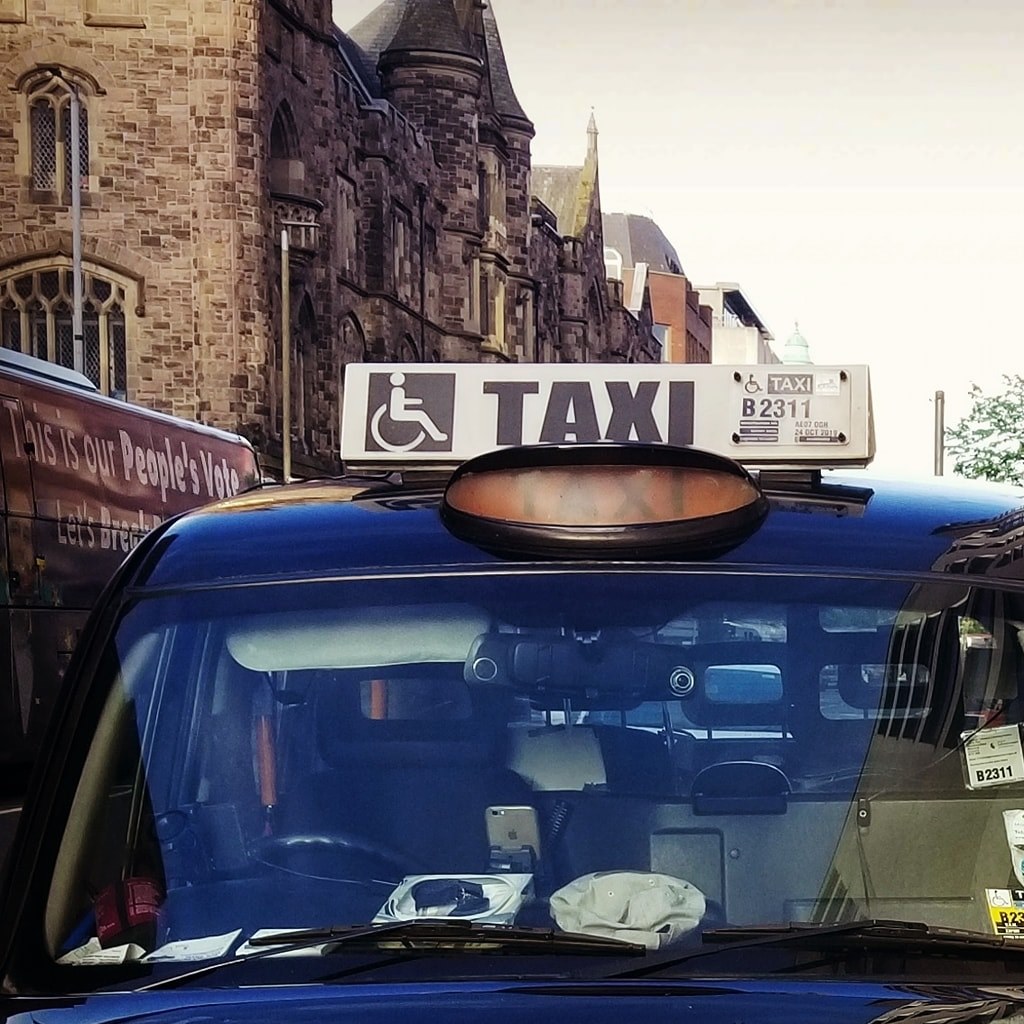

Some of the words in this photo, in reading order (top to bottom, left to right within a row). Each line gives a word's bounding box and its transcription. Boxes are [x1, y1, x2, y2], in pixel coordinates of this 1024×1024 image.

[770, 377, 811, 391] TAXI
[483, 381, 695, 446] TAXI
[2, 401, 57, 467] This
[57, 408, 80, 471] is
[83, 433, 117, 478] our
[119, 430, 200, 502] People's
[199, 450, 240, 499] Vote
[514, 470, 684, 518] TXI
[56, 500, 96, 550] Let's
[976, 765, 1013, 782] B2311
